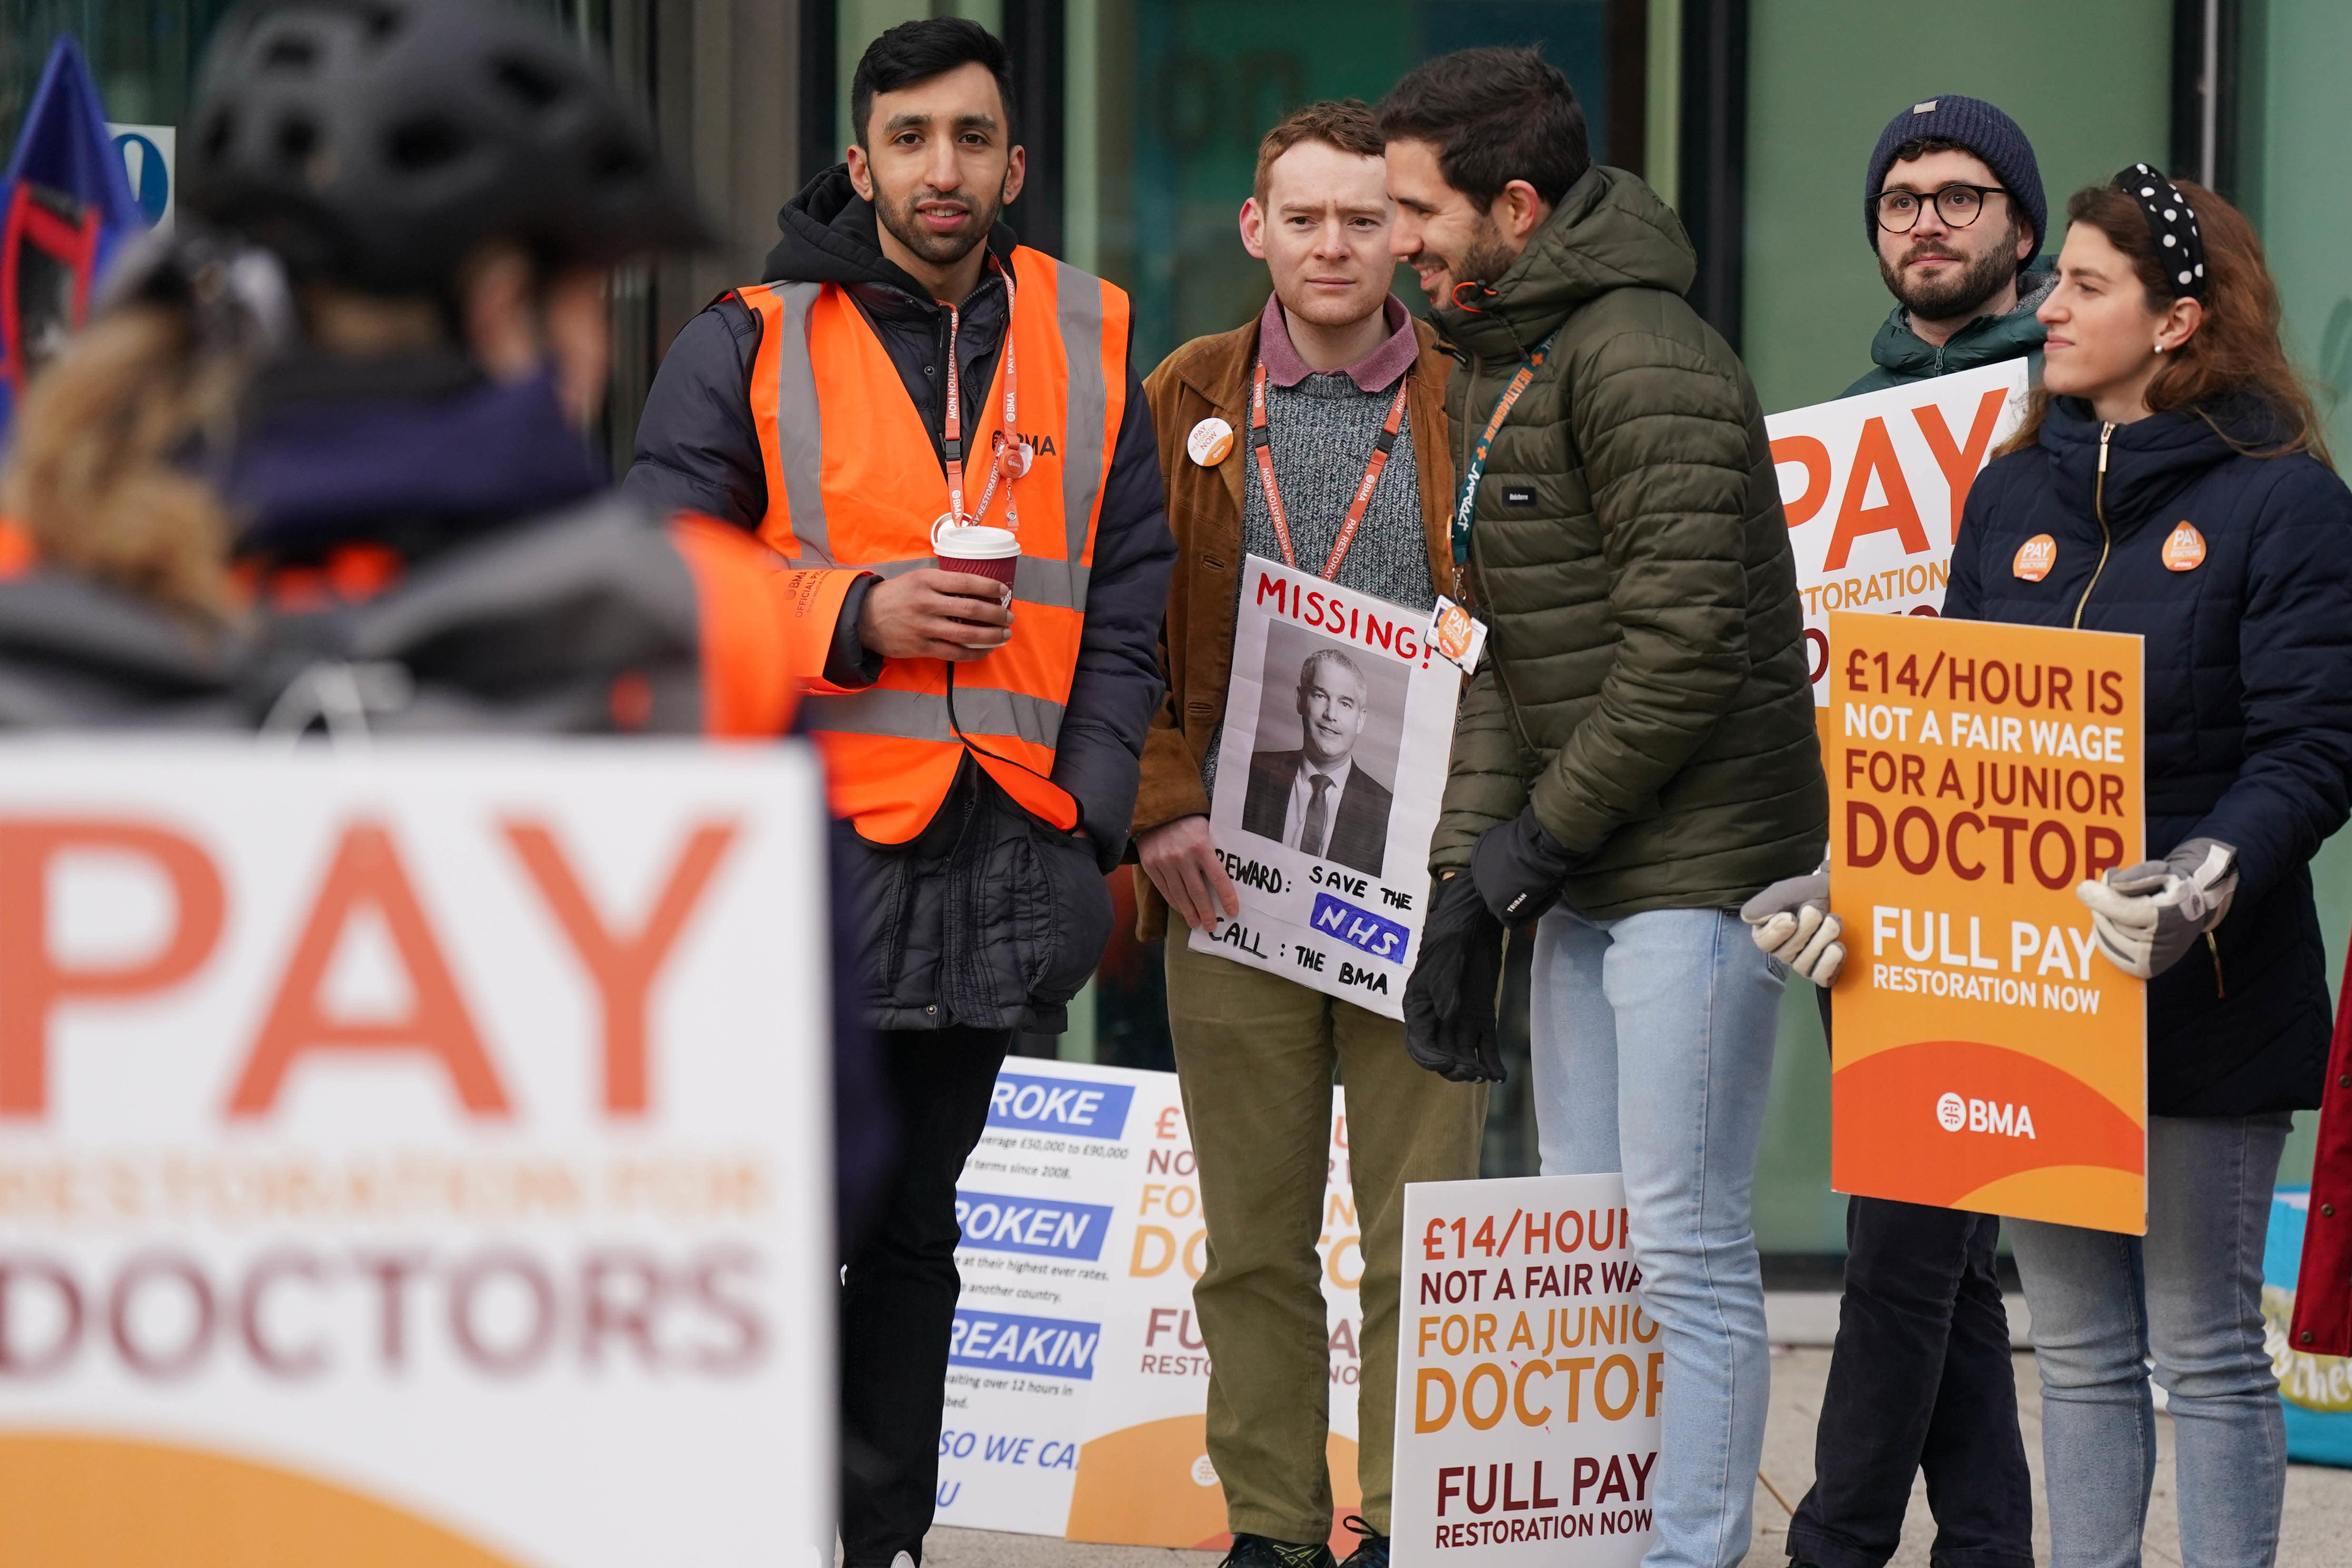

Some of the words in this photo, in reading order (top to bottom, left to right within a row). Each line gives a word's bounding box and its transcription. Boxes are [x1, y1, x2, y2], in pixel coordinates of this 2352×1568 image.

[1004, 273, 1015, 294] NOW
[948, 331, 956, 395] RESTORATION
[948, 397, 957, 419] NOW
[1006, 392, 1015, 412] BMA
[1255, 381, 1263, 400] BMA
[1395, 392, 1406, 414] NOW
[1190, 421, 1219, 453] RESTORATION
[1193, 424, 1207, 441] PAY
[1200, 431, 1217, 451] NOW
[978, 460, 1000, 517] RESTORATION
[1262, 467, 1271, 488] NOW
[1358, 481, 1372, 501] BMA
[952, 498, 961, 519] BMA
[1266, 486, 1289, 551] RESTORATION
[1346, 518, 1357, 534] PAY
[1323, 534, 1349, 581] RESTORAT
[2022, 541, 2054, 558] PAY
[2172, 529, 2197, 547] PAY
[795, 580, 816, 618] OFFICIAL
[1799, 559, 1948, 617] TORATION
[1256, 573, 1432, 669] MISSING!
[1447, 608, 1472, 637] PAY
[1846, 648, 2074, 712] £14/HOUR
[2087, 669, 2124, 715] IS
[1845, 703, 1913, 742] NOT
[1919, 710, 1943, 745] A
[1951, 712, 2023, 753] FAIR
[2029, 719, 2125, 763] WAGE
[1846, 748, 1926, 796] FOR
[1937, 758, 1965, 801] A
[1972, 761, 2125, 818] JUNIOR
[1846, 800, 2124, 891] DOCTOR
[1309, 865, 1368, 898] SAVE
[1380, 888, 1413, 911] THE
[1507, 892, 1528, 912] TRIBAN
[1316, 905, 1400, 956] NHS
[1873, 905, 1998, 970] FULL
[2011, 921, 2097, 981] PAY
[0, 813, 745, 1121] PAY
[1295, 945, 1326, 972] THE
[1338, 962, 1388, 995] BMA
[1873, 964, 2037, 1008] RESTORATION
[2043, 983, 2101, 1015] NOW
[991, 1081, 1105, 1126] ROKE
[1969, 1098, 2036, 1139] BMA
[980, 1137, 1017, 1149] verage
[1147, 1149, 1197, 1177] NO
[1139, 1184, 1204, 1219] FO
[1421, 1269, 1487, 1305] NOT
[1493, 1268, 1516, 1301] A
[1525, 1264, 1594, 1299] FAIR
[1600, 1261, 1641, 1294] WA
[0, 1249, 771, 1384] DOCTORS
[1145, 1307, 1206, 1351] FU
[1418, 1313, 1498, 1358] FOR
[1507, 1311, 1535, 1352] A
[1542, 1304, 1658, 1357] JUNIO
[950, 1318, 1098, 1370] REAKIN
[939, 1430, 976, 1459] SO
[984, 1434, 1034, 1465] WE
[1038, 1441, 1076, 1470] CA
[1437, 1460, 1559, 1517] FULL
[1572, 1451, 1658, 1507] PAY
[1435, 1513, 1594, 1548] RESTORATION
[1601, 1508, 1653, 1535] NOW
